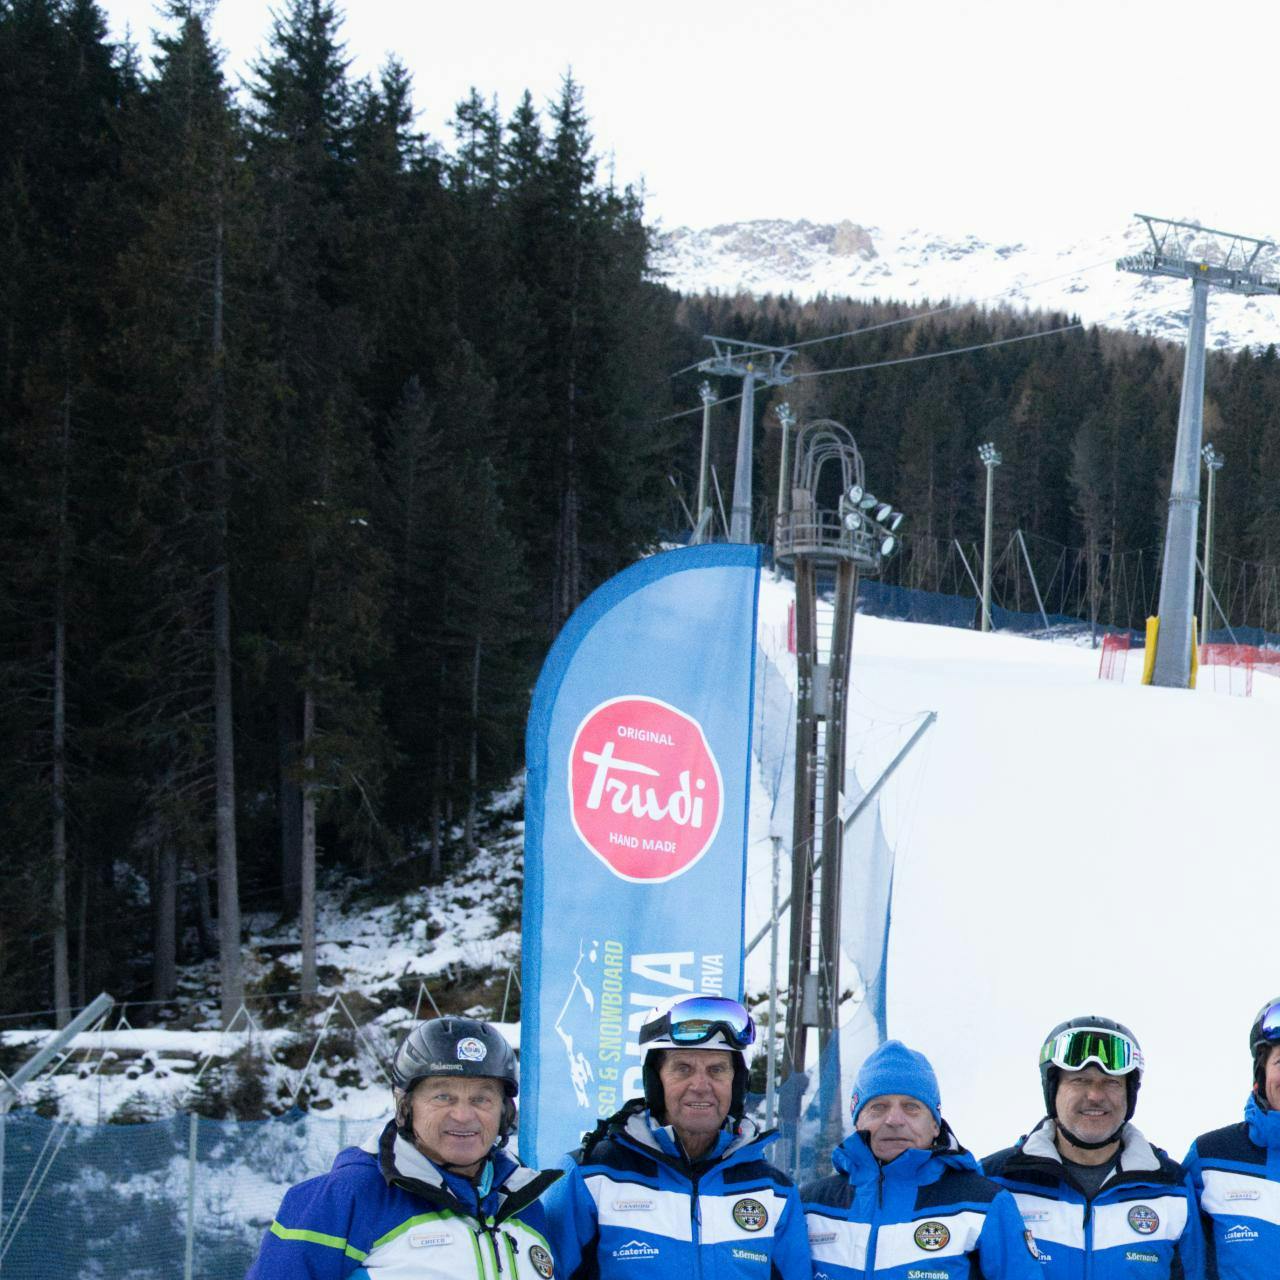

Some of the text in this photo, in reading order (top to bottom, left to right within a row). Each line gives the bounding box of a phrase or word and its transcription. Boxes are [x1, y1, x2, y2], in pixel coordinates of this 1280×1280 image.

[617, 725, 676, 746] ORIGINAL
[582, 741, 706, 829] Trudi
[609, 832, 677, 853] HAND MADE
[598, 940, 624, 1063] SNOWBOARD
[598, 1087, 616, 1116] SCI
[612, 1246, 660, 1257] s.caterina
[1126, 1252, 1158, 1262] S.Bernardo
[908, 1270, 949, 1280] S.Bernardo
